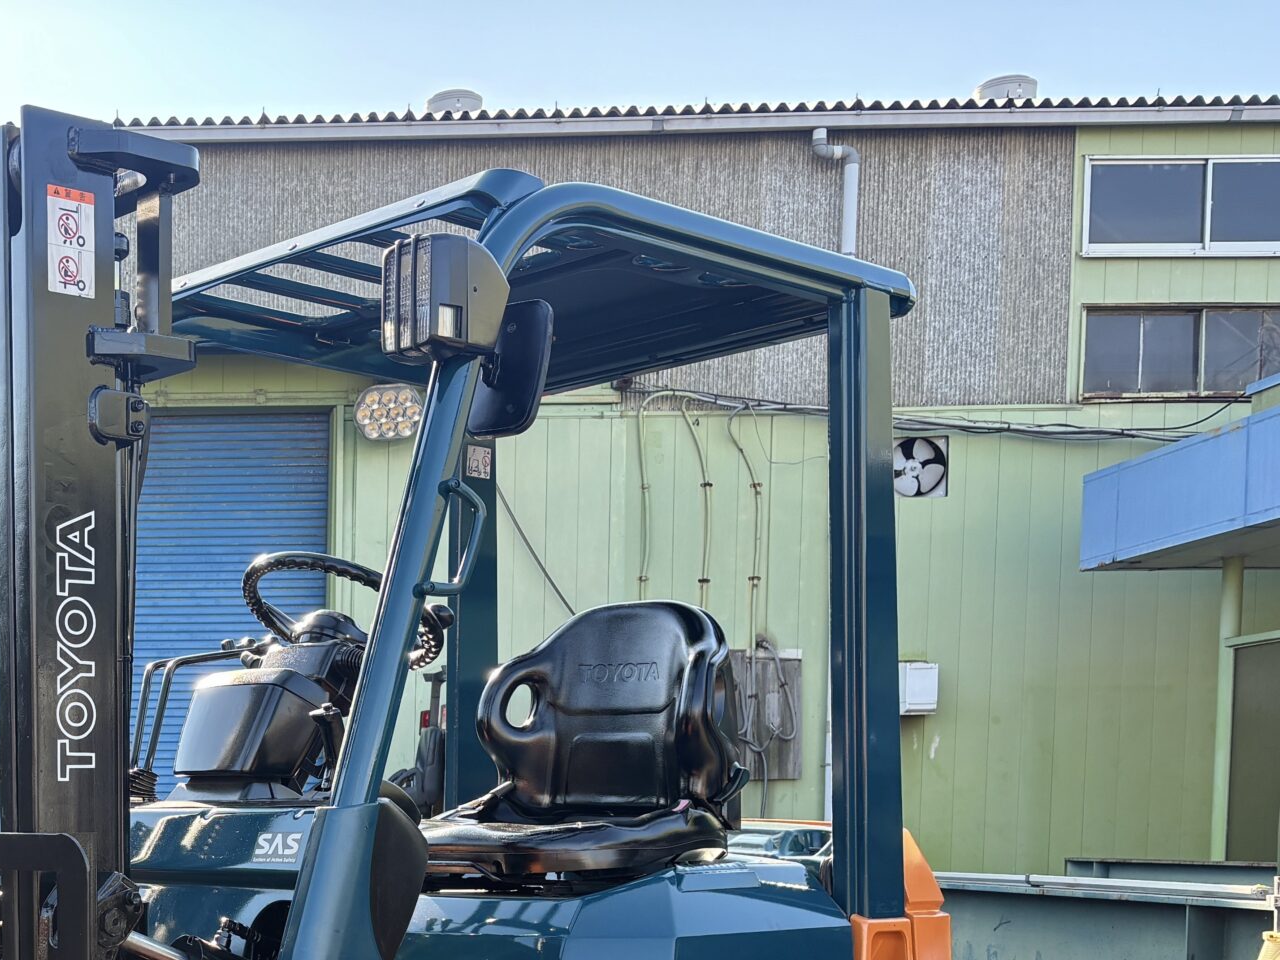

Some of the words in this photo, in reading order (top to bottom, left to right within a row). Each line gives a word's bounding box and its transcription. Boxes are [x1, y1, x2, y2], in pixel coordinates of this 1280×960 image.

[56, 510, 96, 782] TOYOTA
[578, 662, 659, 682] TOYOTA
[255, 833, 303, 854] SAS
